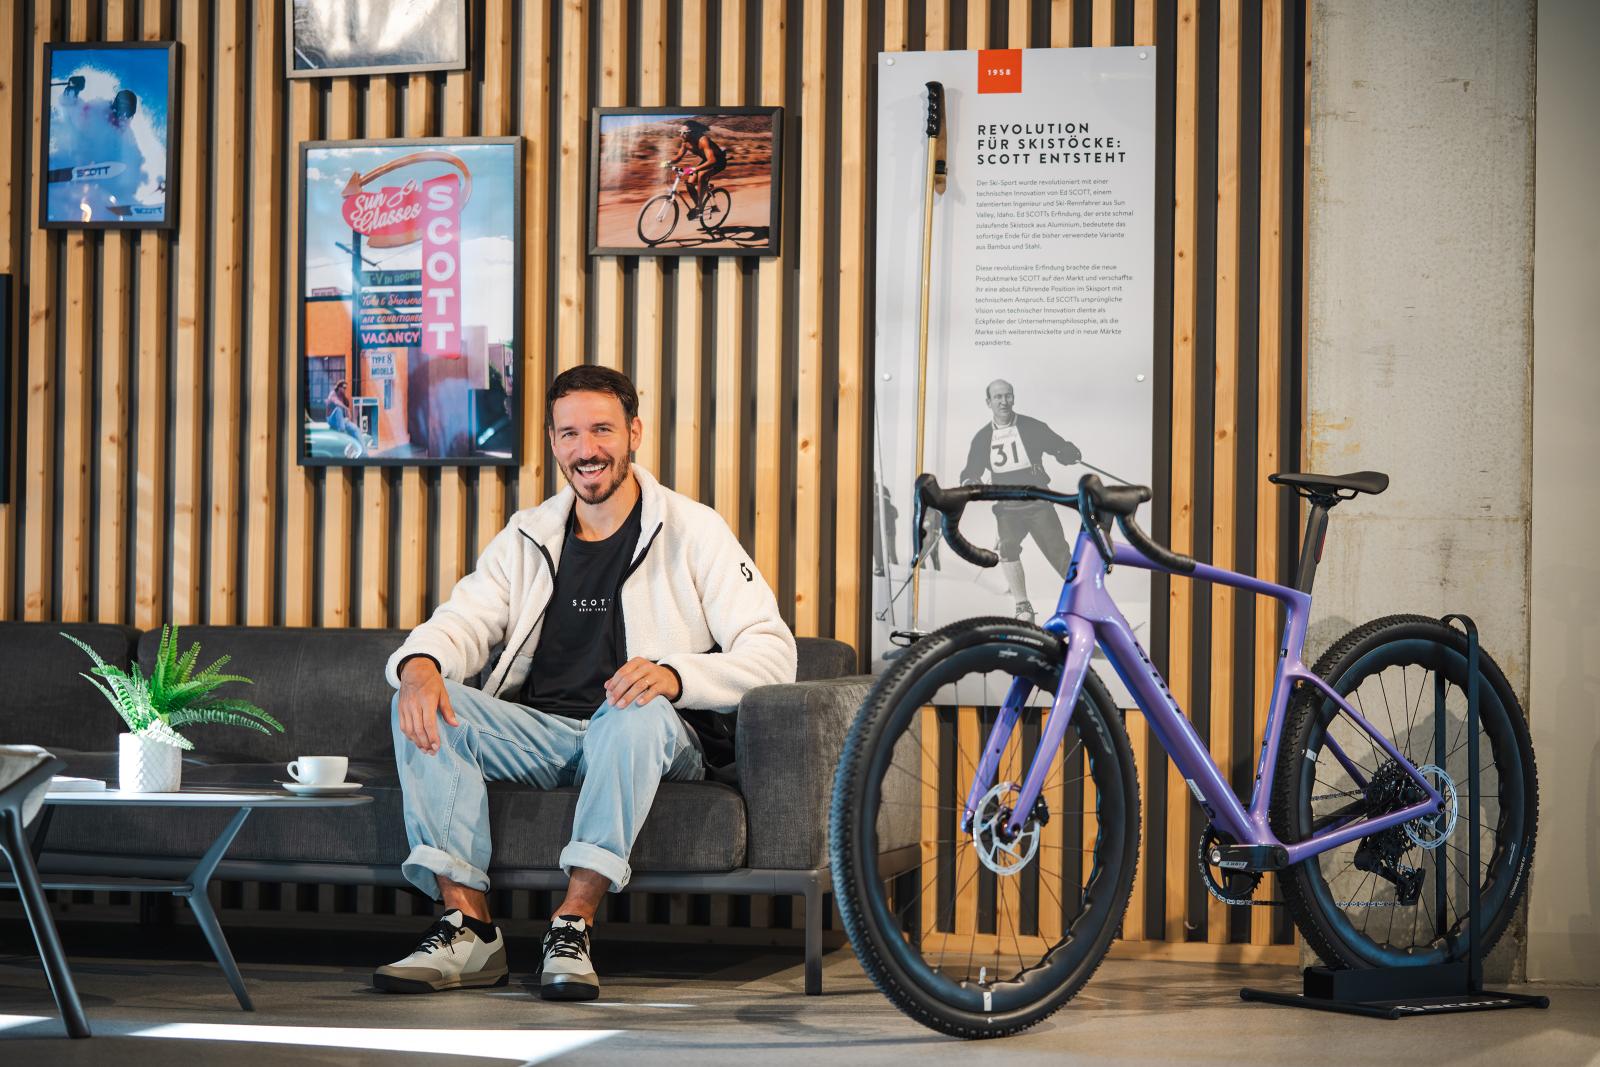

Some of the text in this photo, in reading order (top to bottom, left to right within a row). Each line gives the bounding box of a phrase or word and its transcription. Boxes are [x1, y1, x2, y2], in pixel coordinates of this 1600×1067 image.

[978, 123, 1089, 135] REVOLUTION
[978, 135, 1121, 150] FÜR SKISTÖCKE:
[978, 152, 1126, 164] SCOTT ENTSTEHT
[77, 166, 111, 178] SCOTT
[350, 193, 386, 220] Sun
[353, 203, 422, 233] Glasses
[426, 184, 456, 350] SCOTT
[1080, 296, 1122, 304] ursprüngliche
[361, 331, 420, 344] VACANCY
[372, 355, 385, 364] TYPE
[991, 441, 1019, 467] 31
[572, 599, 610, 607] SCOT
